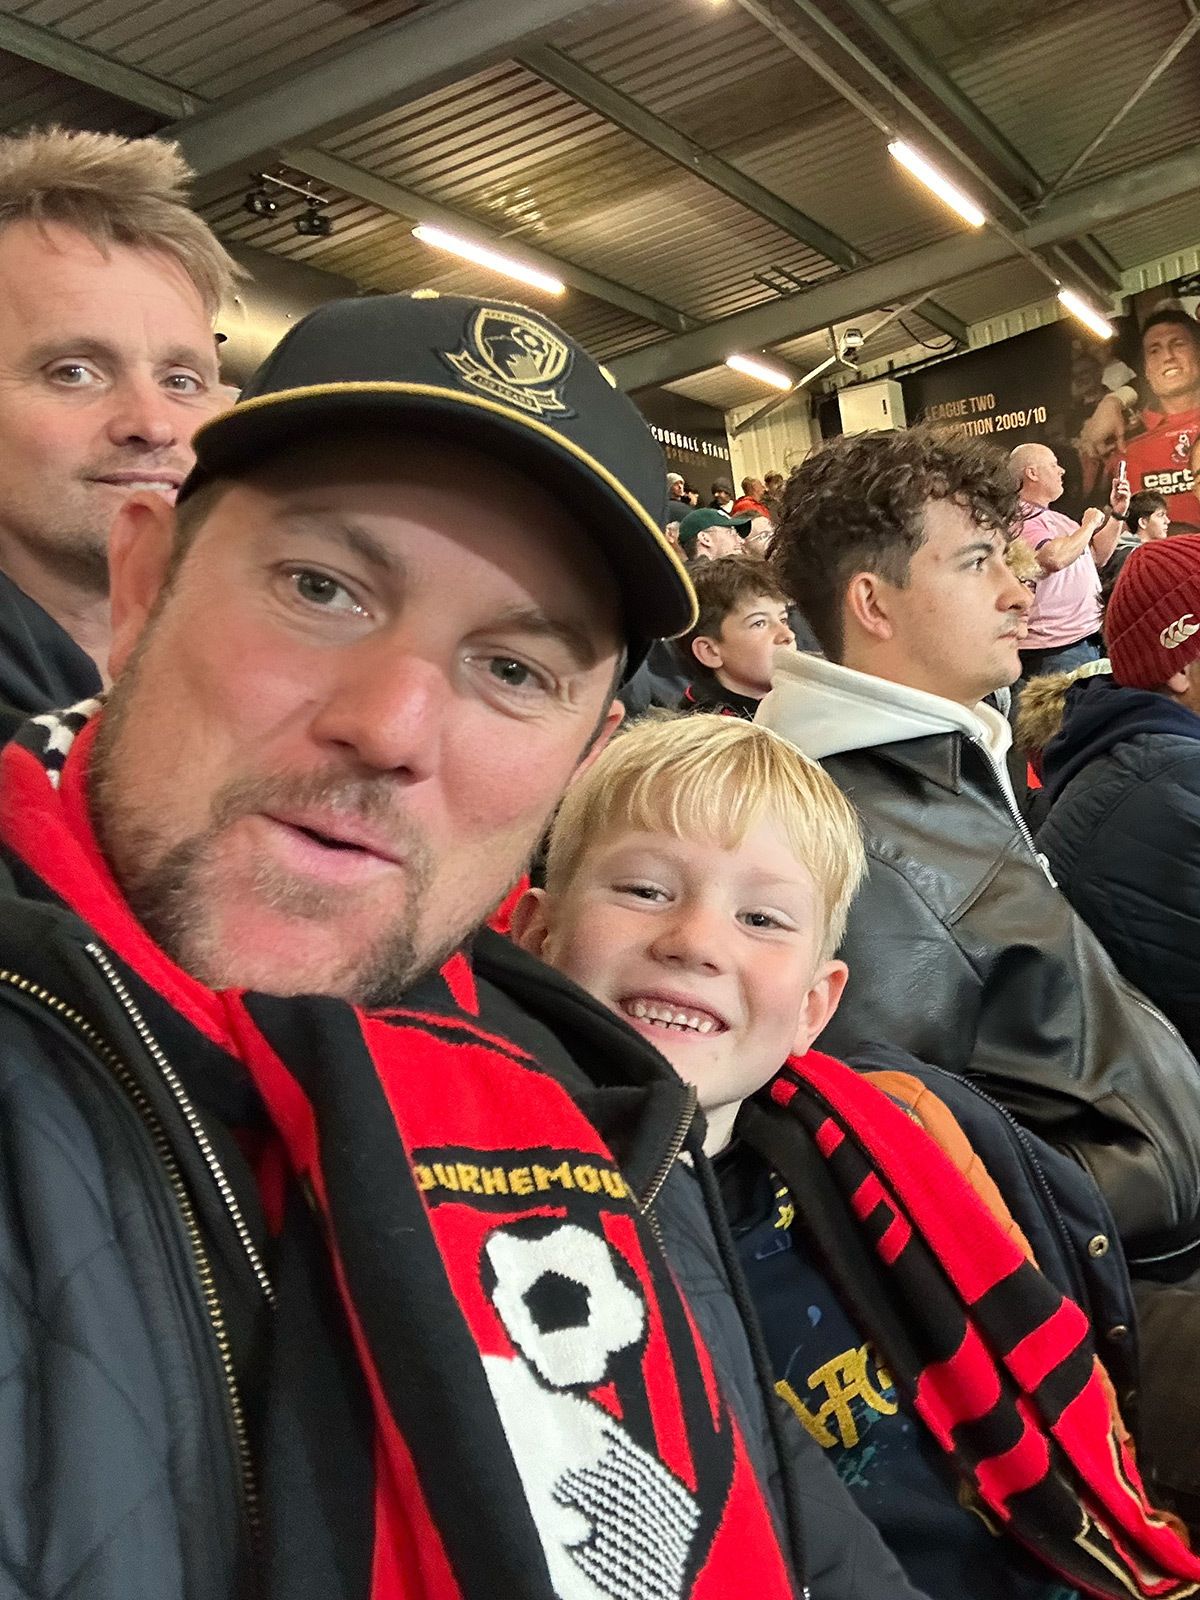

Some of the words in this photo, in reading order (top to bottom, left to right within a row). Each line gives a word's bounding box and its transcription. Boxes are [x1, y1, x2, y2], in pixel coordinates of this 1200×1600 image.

[968, 393, 996, 413] TWO
[995, 406, 1047, 432] 2009/10
[702, 441, 730, 461] STAND
[413, 1160, 627, 1198] OURNEMOU
